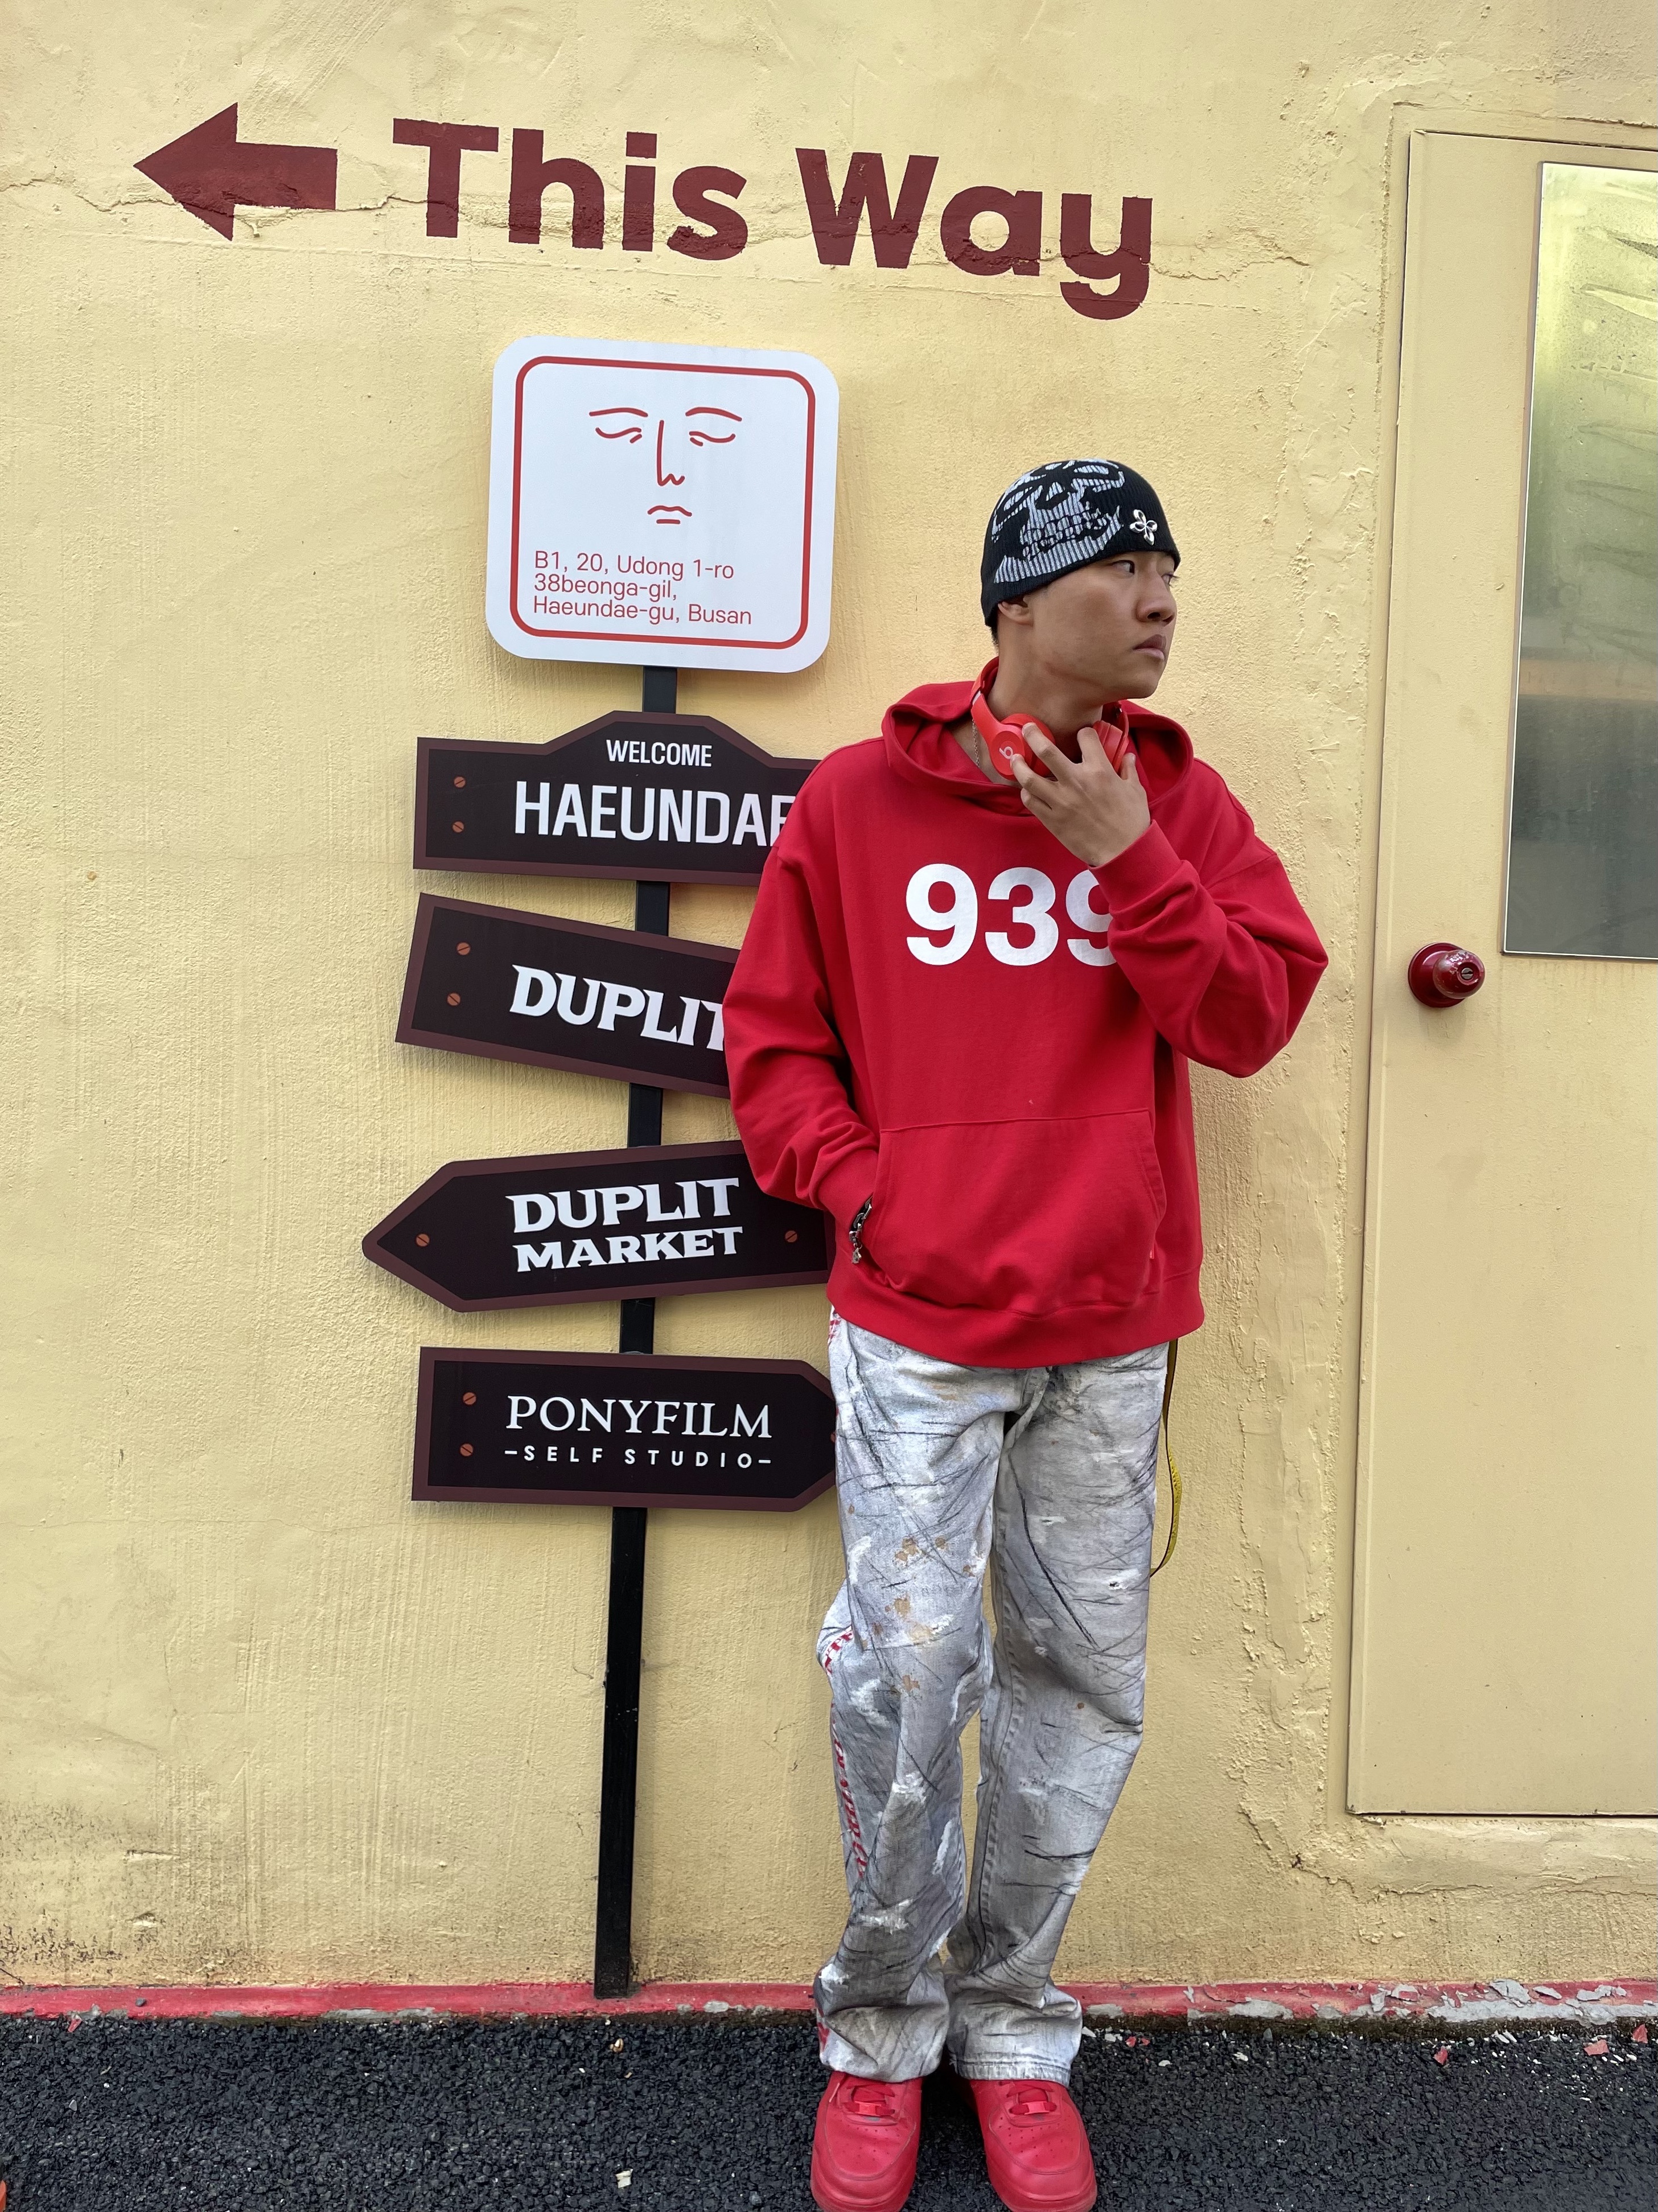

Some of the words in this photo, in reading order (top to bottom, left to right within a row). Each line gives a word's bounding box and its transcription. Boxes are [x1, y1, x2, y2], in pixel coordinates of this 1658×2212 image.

[393, 118, 748, 261] This
[796, 147, 1153, 320] Way
[535, 550, 567, 572] B1,
[577, 553, 608, 574] 20,
[617, 556, 684, 581] Udong
[693, 559, 734, 579] 1-ro
[534, 573, 677, 601] 38beonga-gil,
[533, 596, 680, 624] Haeundae-gu,
[689, 604, 752, 624] Busan
[606, 739, 712, 767] WELCOME
[505, 1177, 739, 1233] DUPLIT
[513, 1227, 743, 1272] MARKET
[506, 1395, 772, 1438] PONYFILM
